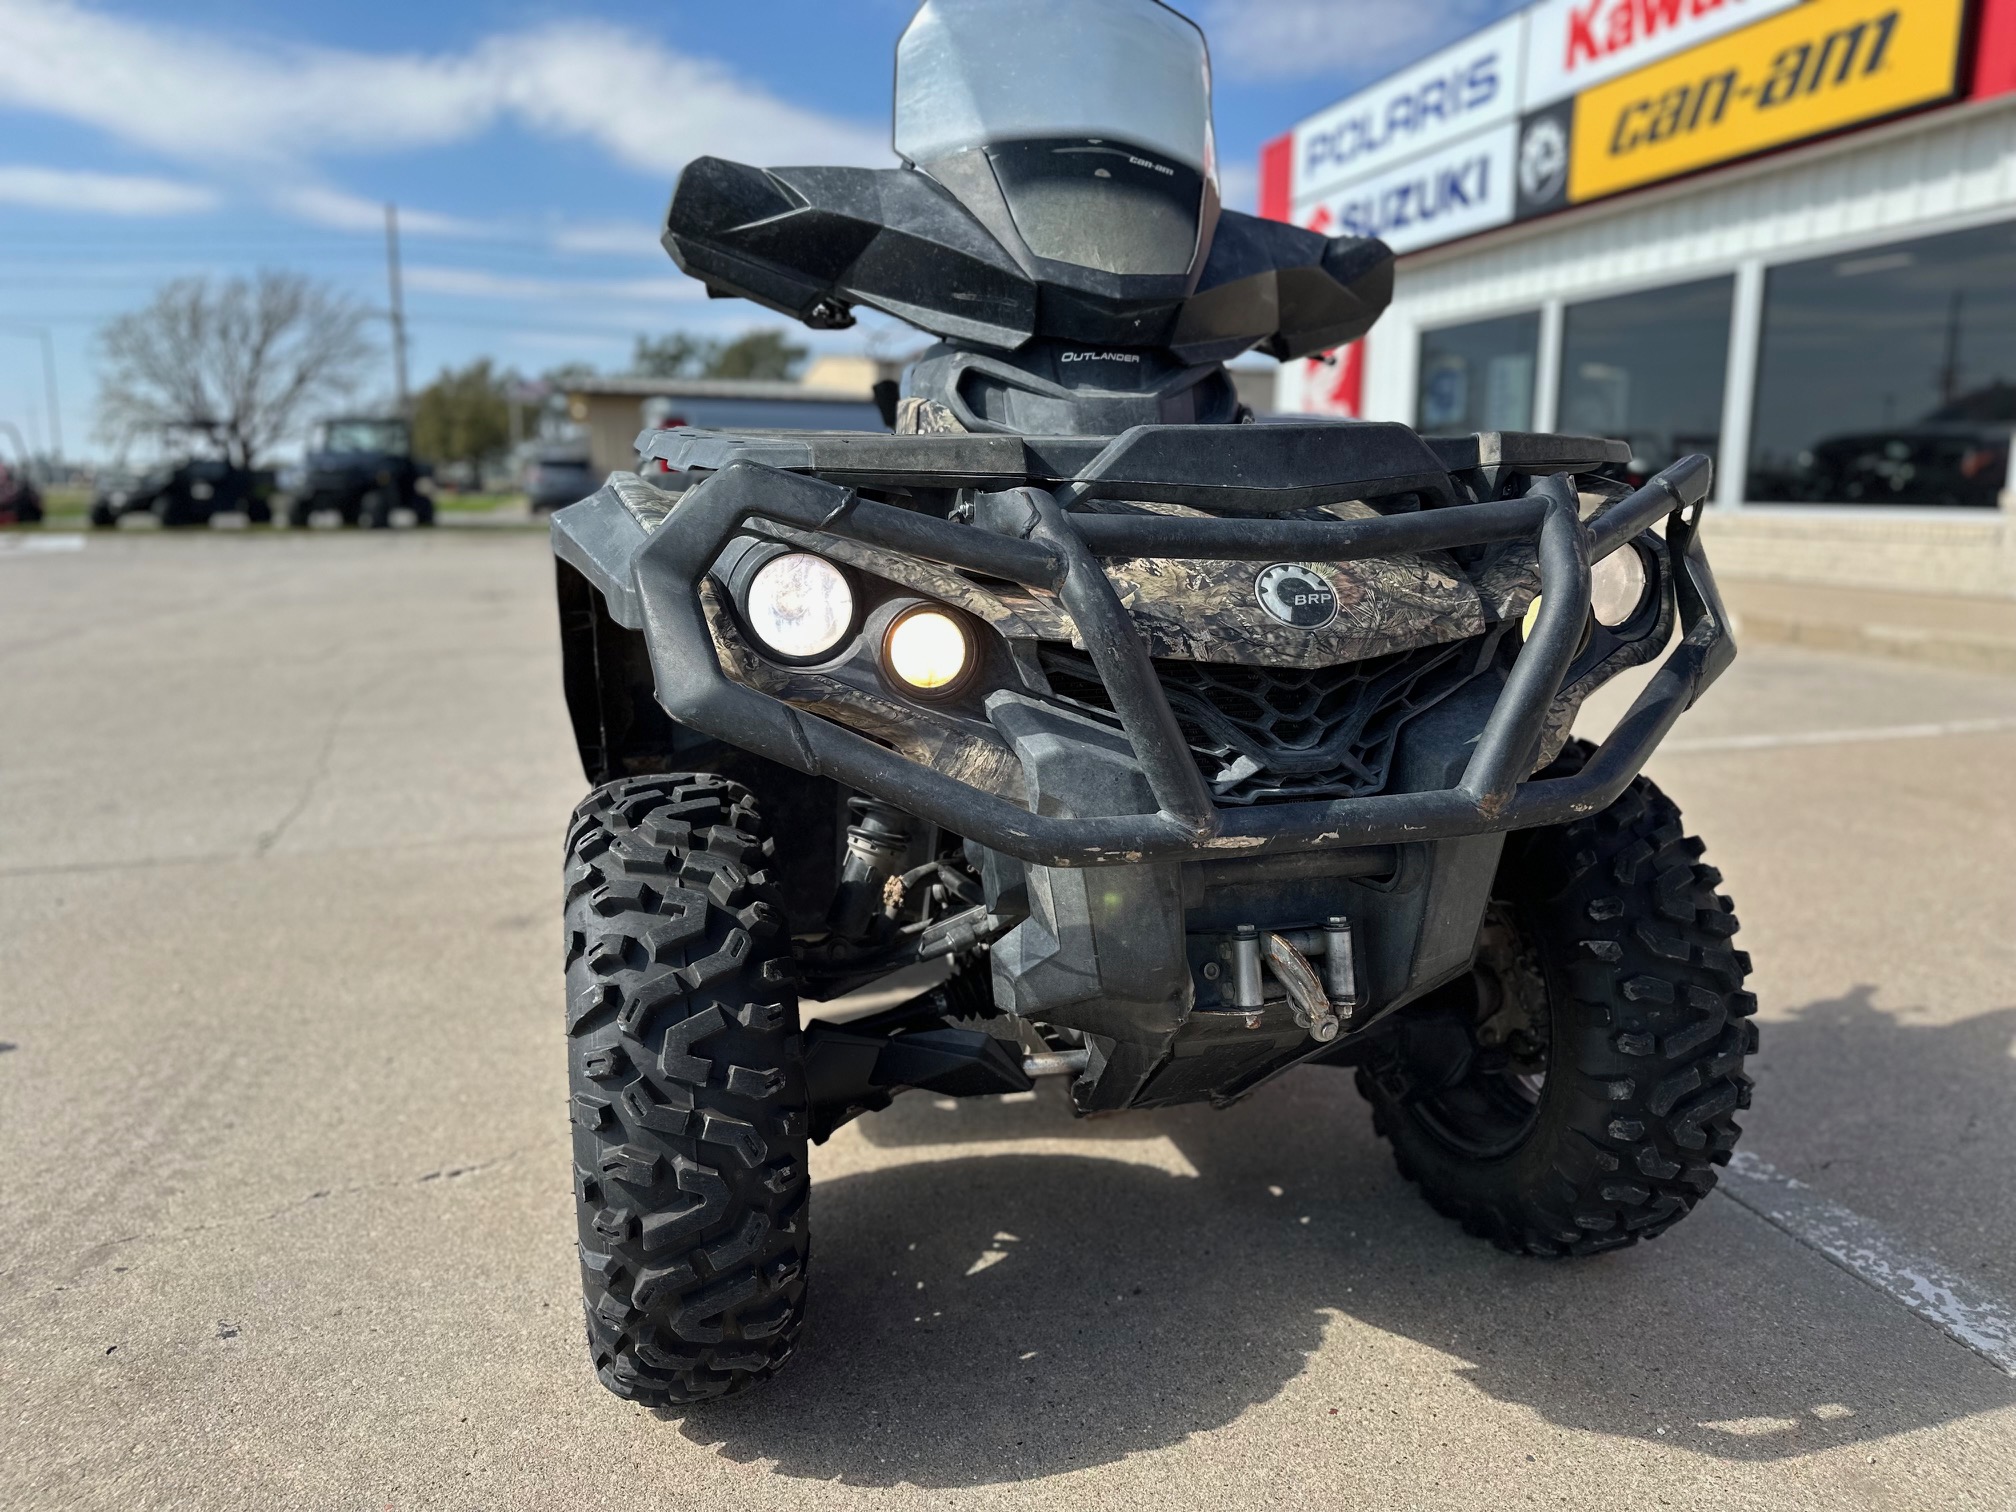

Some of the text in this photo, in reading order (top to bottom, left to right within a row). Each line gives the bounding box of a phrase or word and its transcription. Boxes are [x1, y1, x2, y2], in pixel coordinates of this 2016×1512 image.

[1608, 10, 1899, 155] can-am
[1305, 53, 1499, 179] POLARIS
[1129, 155, 1175, 176] can-am
[1340, 155, 1490, 238] SUZUKI
[1061, 351, 1140, 363] OUTLANDER
[1294, 593, 1332, 606] BRP
